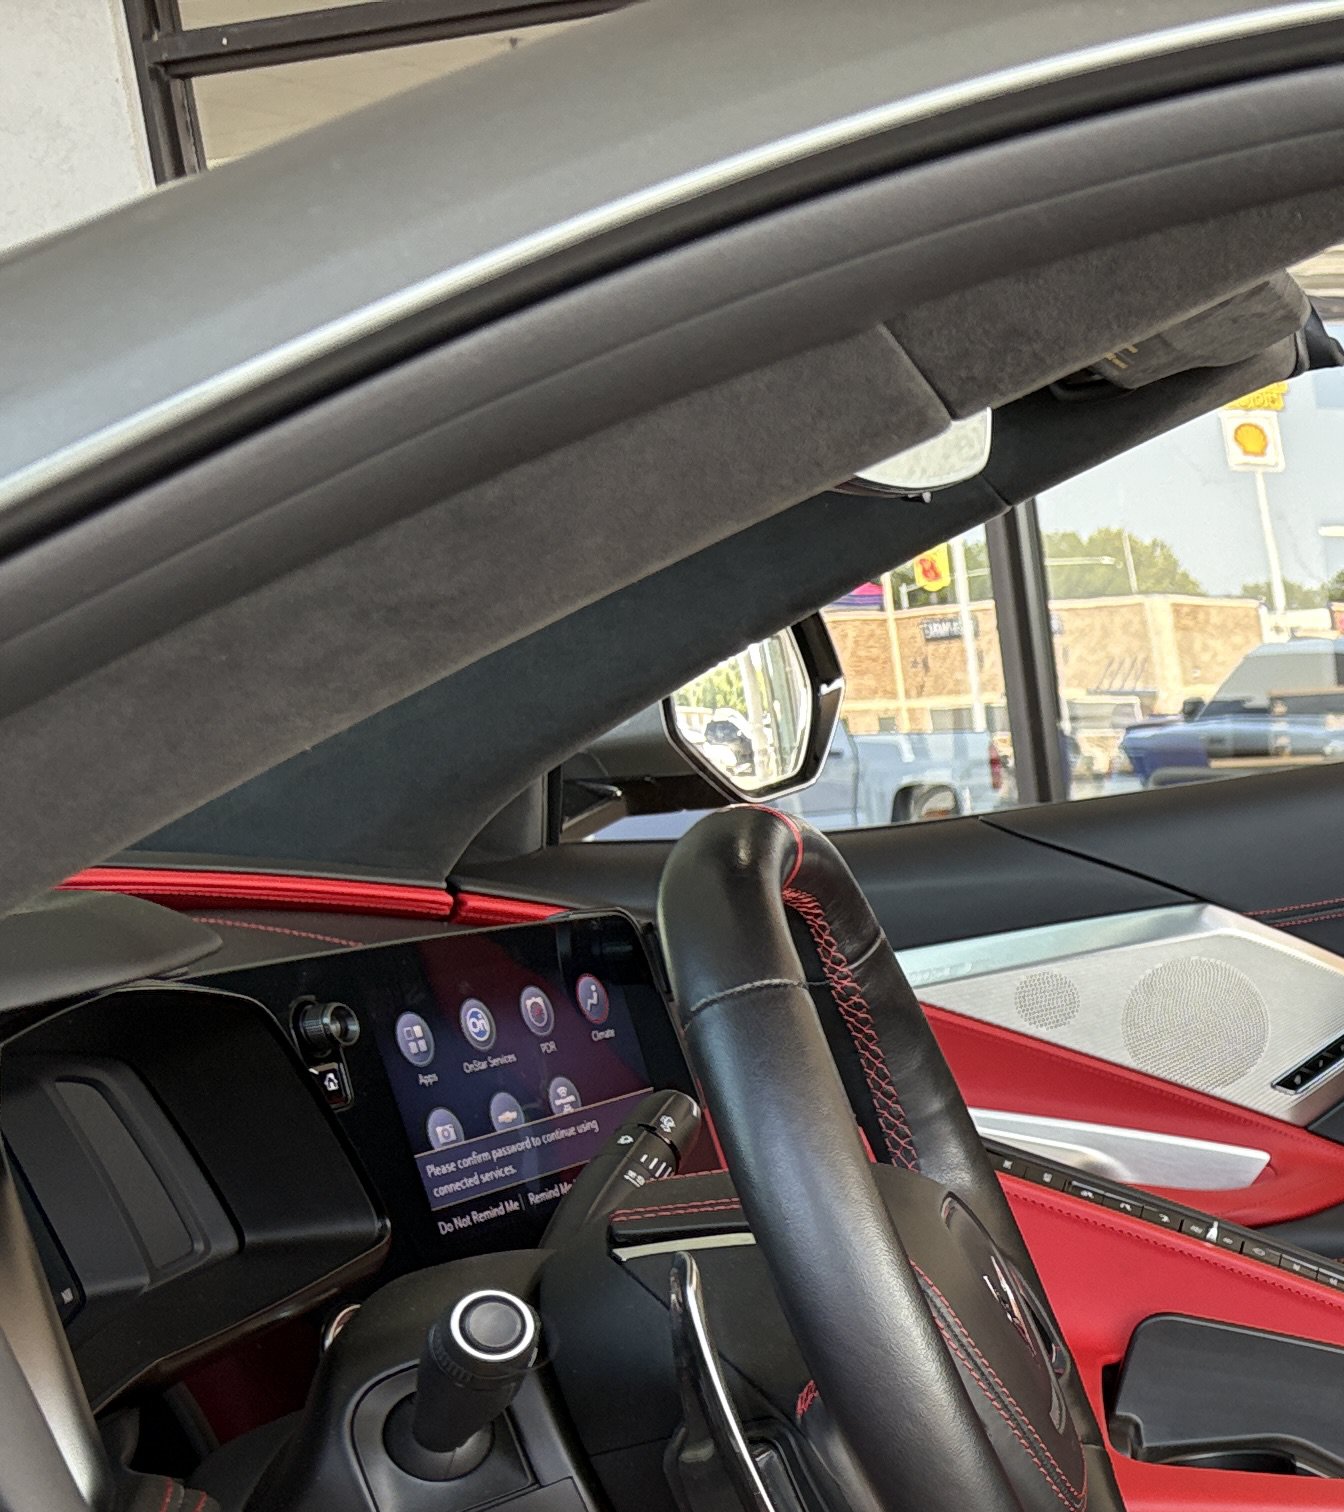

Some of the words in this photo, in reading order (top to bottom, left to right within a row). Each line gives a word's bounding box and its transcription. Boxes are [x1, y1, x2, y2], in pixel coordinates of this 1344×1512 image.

[463, 1060, 488, 1074] OnStar
[487, 1053, 518, 1068] Services
[418, 1072, 439, 1087] Apps
[425, 1161, 457, 1178] Please
[457, 1151, 491, 1169] confirm
[491, 1136, 532, 1162] password
[531, 1135, 542, 1146] to
[541, 1125, 577, 1144] continue
[576, 1119, 600, 1134] using
[433, 1172, 480, 1197] connected
[479, 1164, 518, 1183] services.
[527, 1184, 560, 1205] Remind
[438, 1220, 454, 1235] Do
[453, 1215, 471, 1229] Not
[471, 1203, 505, 1224] Remind
[505, 1200, 520, 1214] Me
